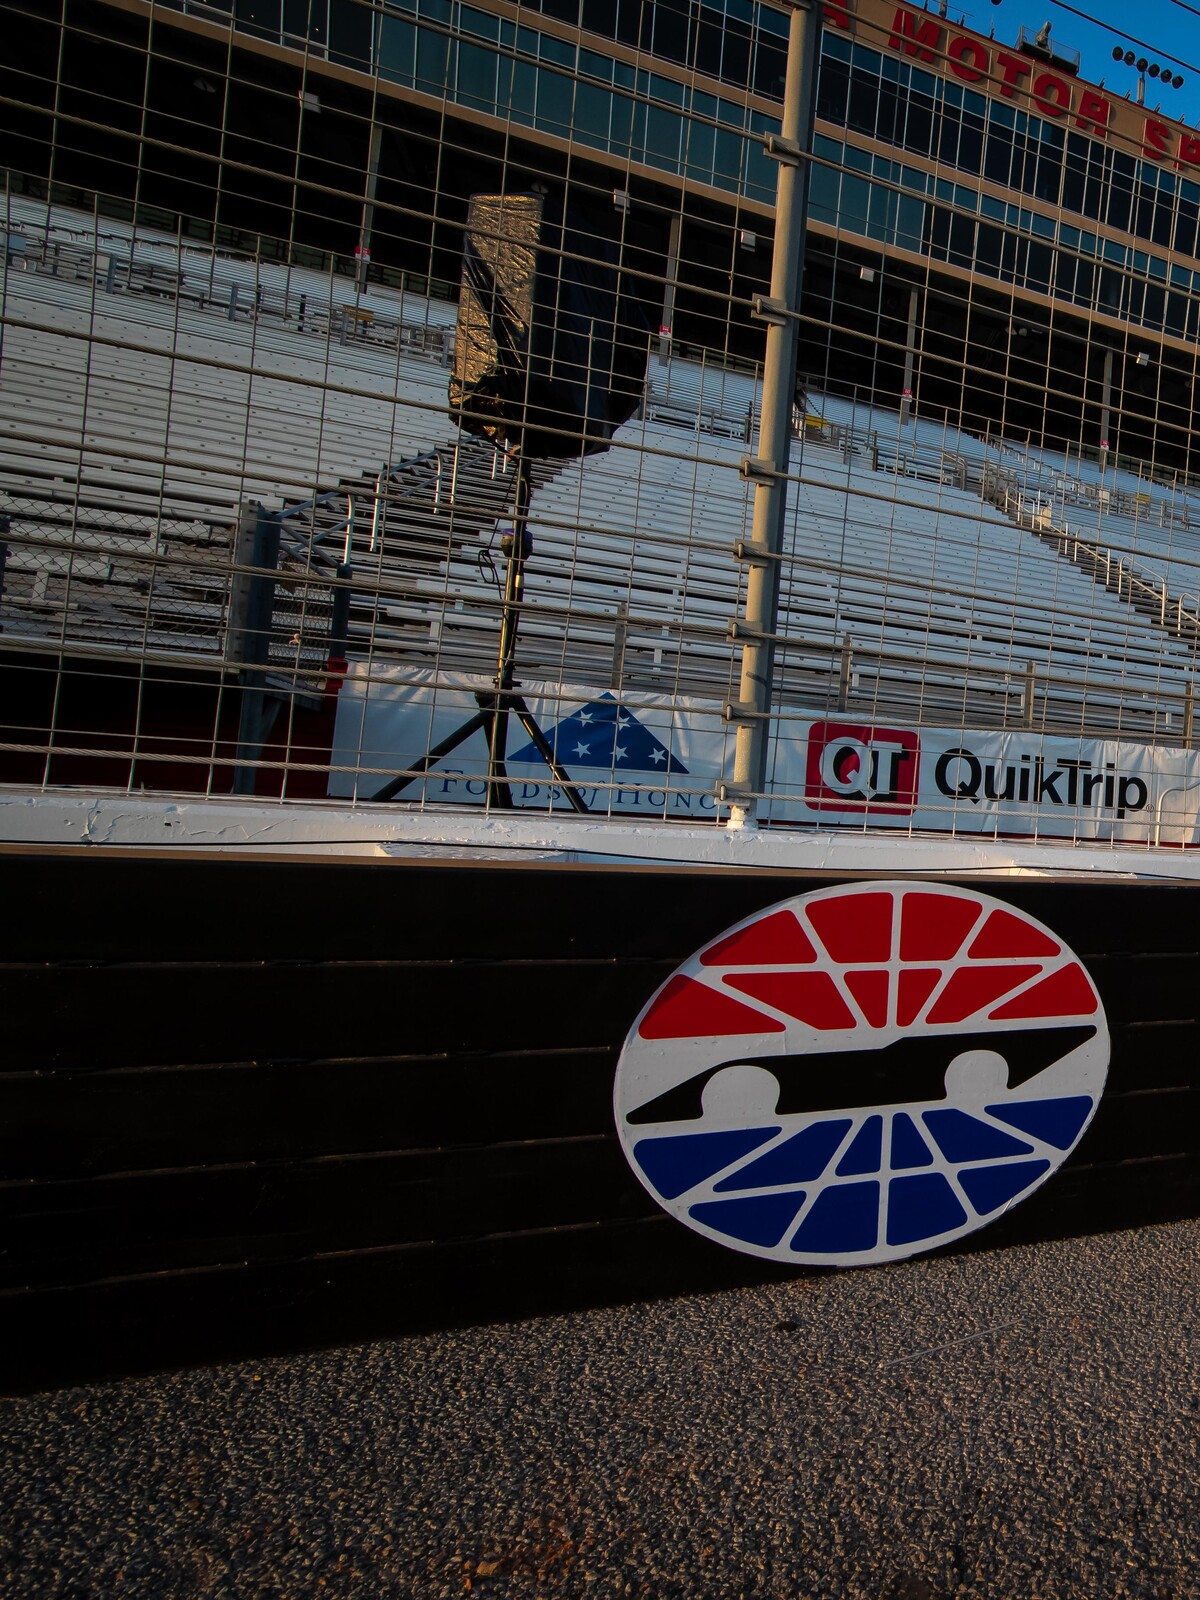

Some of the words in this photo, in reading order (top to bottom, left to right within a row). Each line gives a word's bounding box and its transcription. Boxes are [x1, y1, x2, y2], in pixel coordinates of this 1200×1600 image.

[888, 7, 1110, 138] MOTOR
[438, 768, 561, 800] FODS
[615, 781, 732, 810] HONO
[819, 736, 909, 803] QT
[934, 747, 1148, 819] QuikTrip
